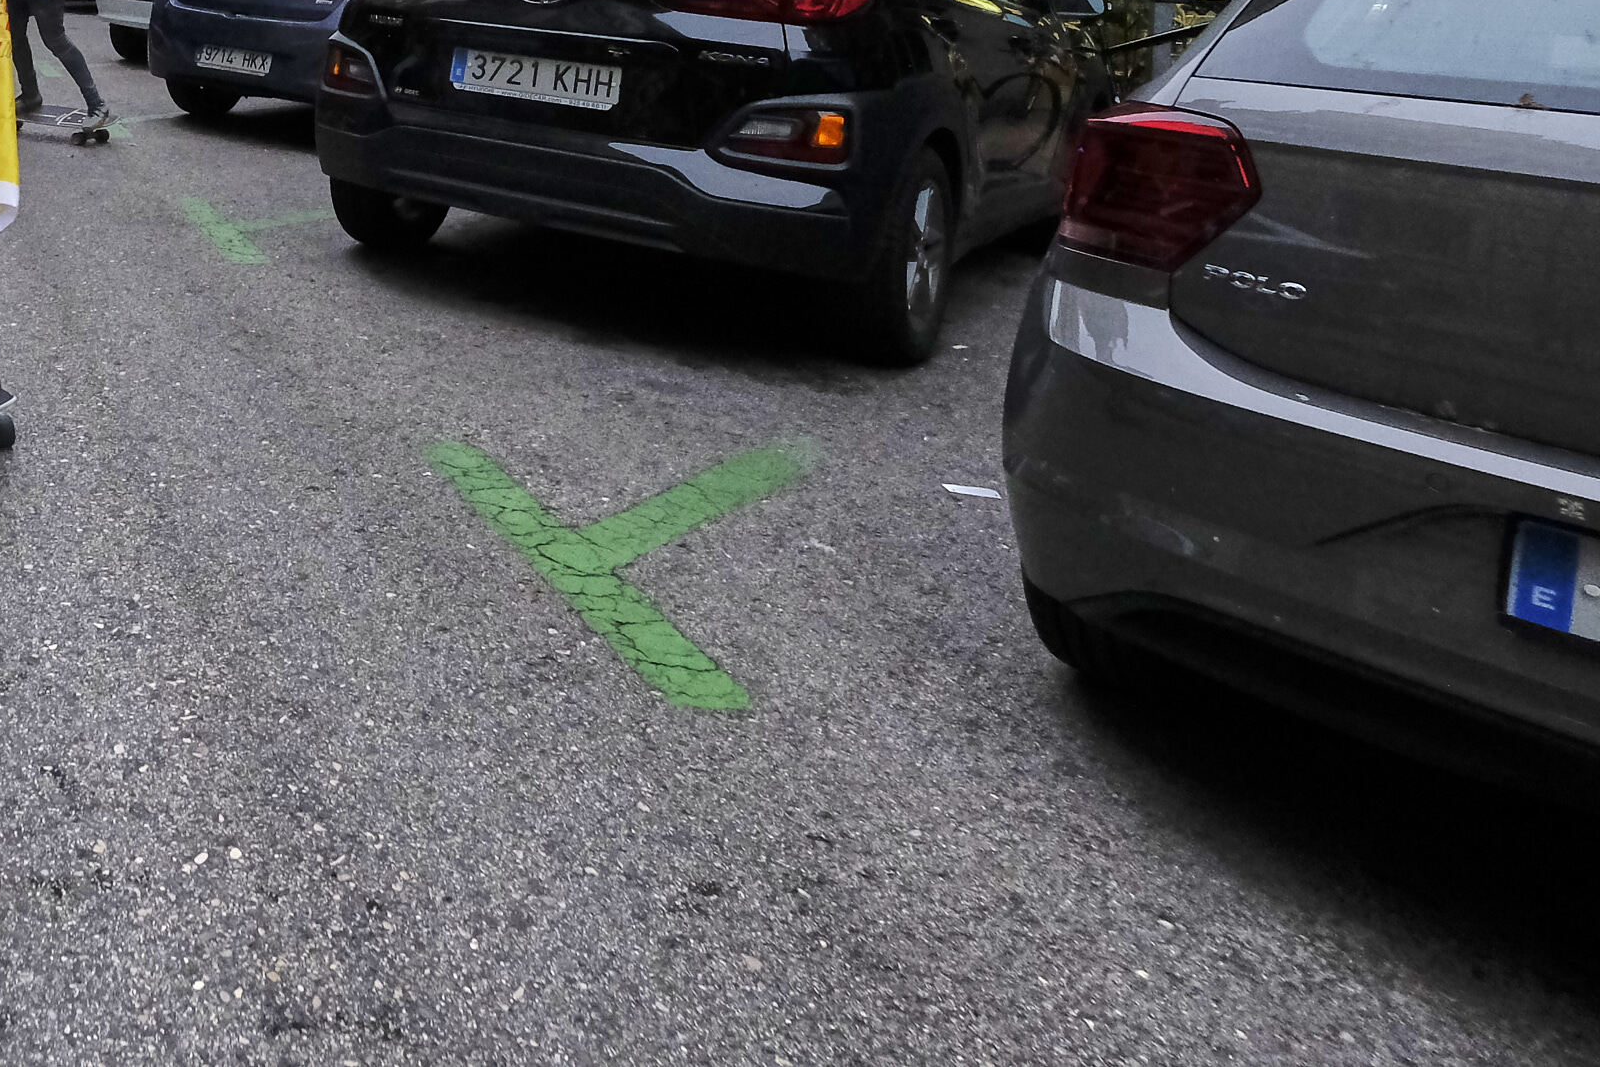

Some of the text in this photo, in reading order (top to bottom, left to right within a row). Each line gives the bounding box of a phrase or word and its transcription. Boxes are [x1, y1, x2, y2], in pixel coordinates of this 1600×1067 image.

[241, 53, 268, 71] HKX
[471, 53, 614, 98] 3721 KHH
[1203, 262, 1307, 300] POLO
[1531, 585, 1557, 611] E
